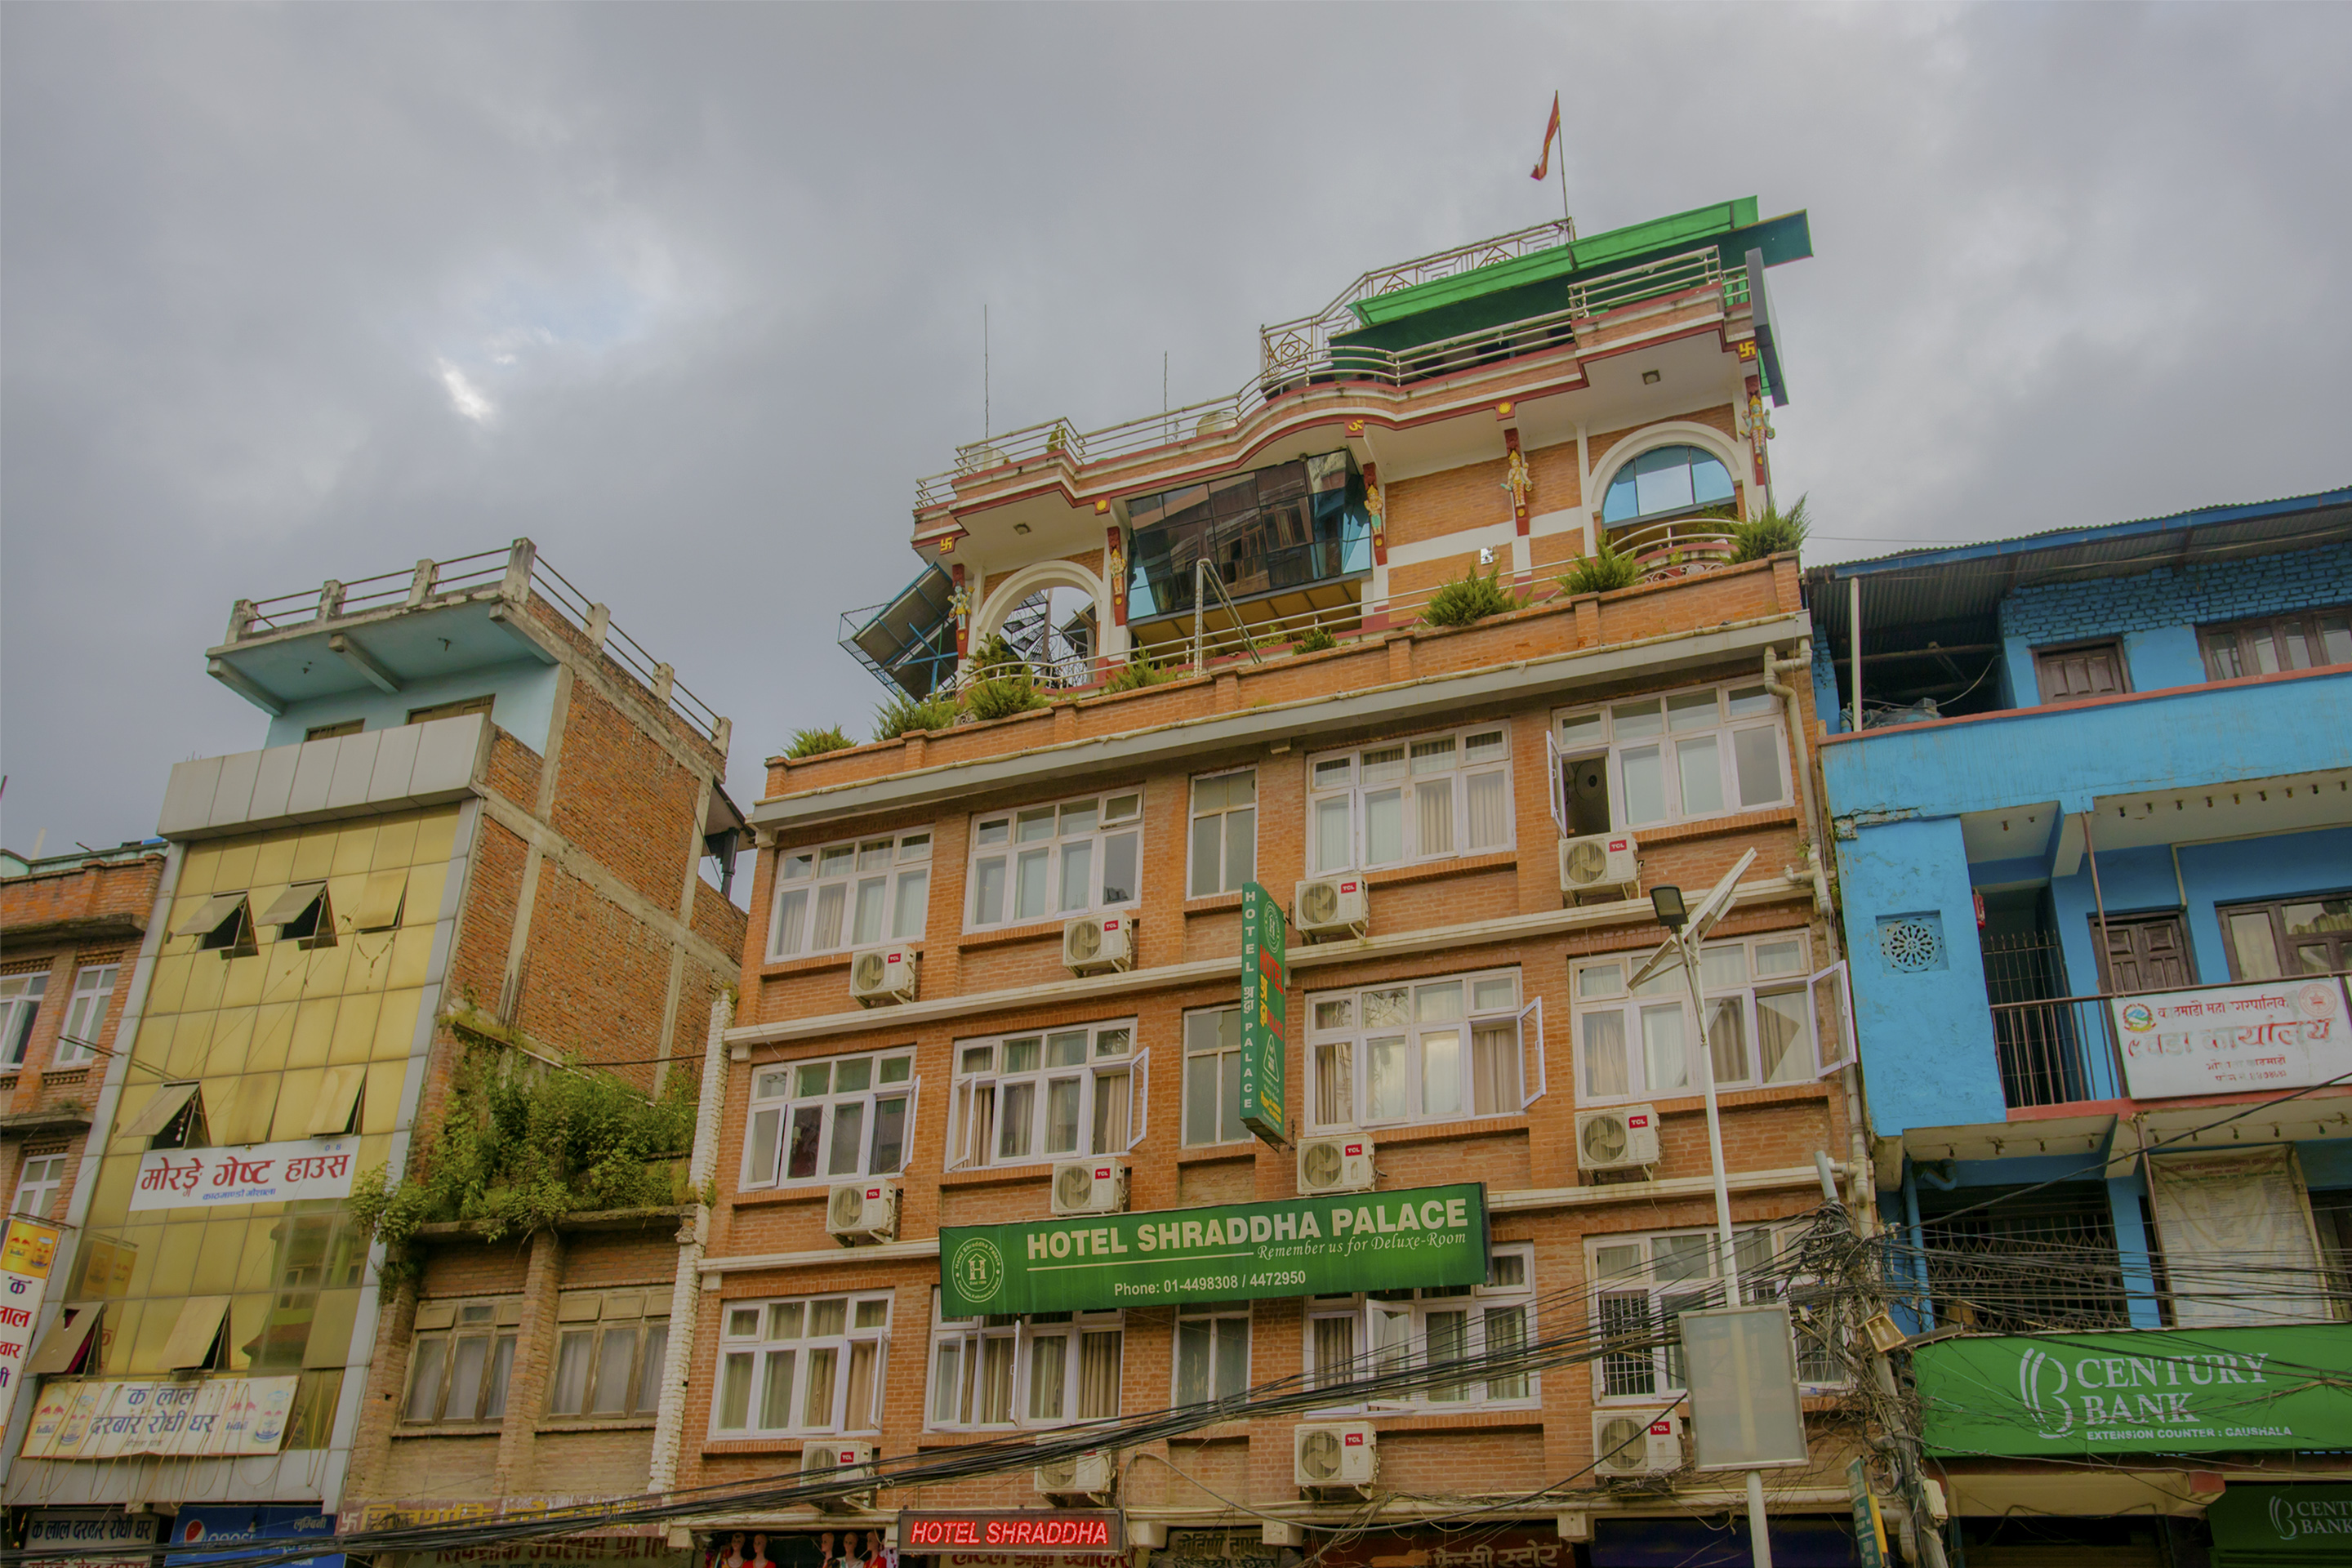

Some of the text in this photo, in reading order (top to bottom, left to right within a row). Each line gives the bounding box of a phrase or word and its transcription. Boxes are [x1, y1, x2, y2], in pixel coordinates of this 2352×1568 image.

[1245, 891, 1256, 973] HOTEL
[1260, 944, 1284, 995] HOTEL
[1244, 1022, 1254, 1108] PALACE
[285, 1155, 351, 1183] हाउस
[1027, 1198, 1468, 1260] HOTEL SHRADDHA PALACE
[1257, 1232, 1467, 1260] Remember us for Deluxe-Room
[8, 1276, 33, 1295] क
[1114, 1281, 1160, 1298] Phone:
[1163, 1274, 1239, 1294] 01-4498308
[1250, 1270, 1307, 1288] 4472950
[2075, 1353, 2269, 1389] CENTURY
[127, 1386, 201, 1405] क लाल
[2079, 1392, 2200, 1426] BANK
[91, 1414, 146, 1435] दरबार
[2087, 1429, 2154, 1441] EXTENSION
[2157, 1428, 2215, 1439] COUNTER
[2225, 1426, 2292, 1437] GAUSHALA
[2296, 1501, 2352, 1517] CENT
[32, 1520, 45, 1539] क
[45, 1520, 72, 1540] लाल
[910, 1520, 1110, 1546] HOTEL SHRADDHA
